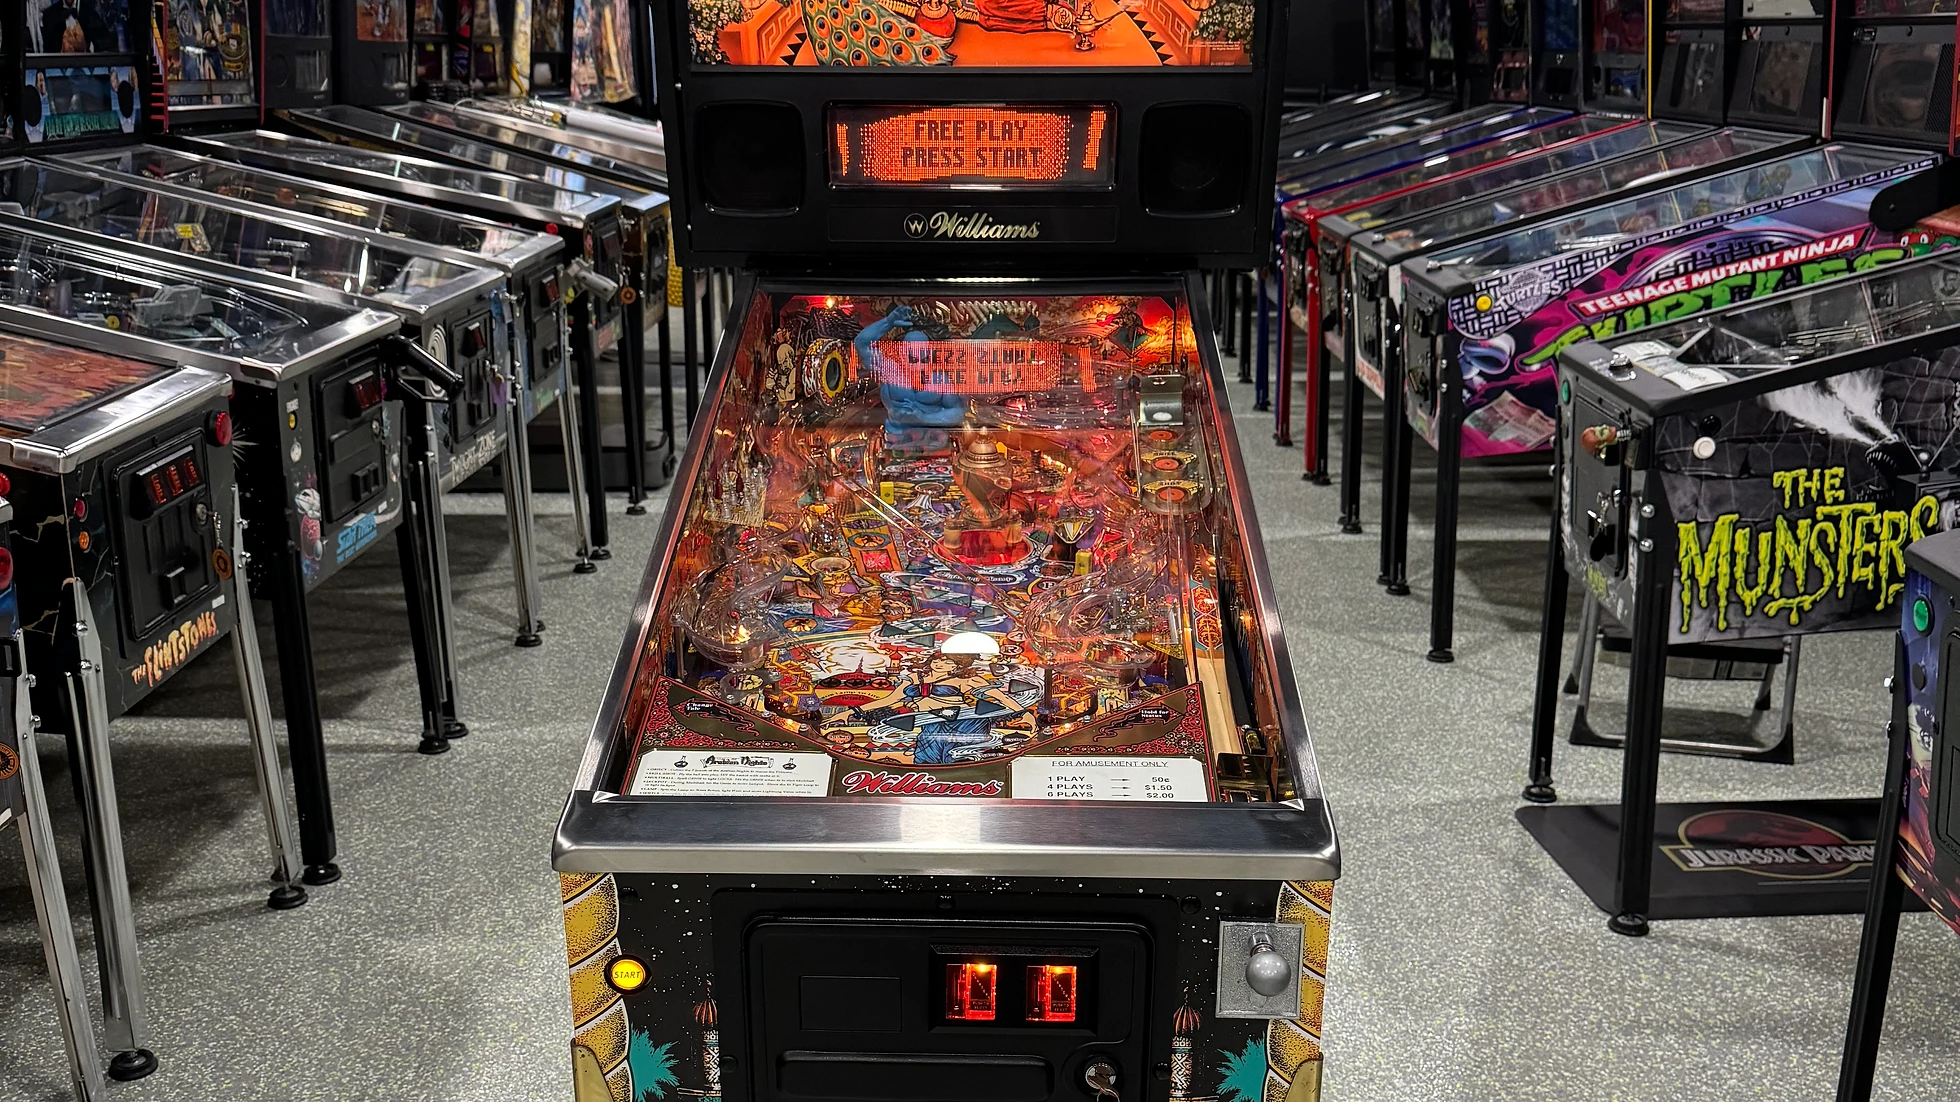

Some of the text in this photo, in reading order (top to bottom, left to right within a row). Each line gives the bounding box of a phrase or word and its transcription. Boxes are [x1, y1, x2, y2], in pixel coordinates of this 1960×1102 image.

[914, 119, 1028, 141] FREE PLAY
[902, 146, 1042, 168] PRESS START
[929, 211, 1040, 239] Williams
[1581, 233, 1855, 314] TEENAGE MUTANT NINJA
[1495, 279, 1561, 312] TURTLES
[1773, 466, 1845, 510] THE
[144, 611, 217, 688] FLINTSTONES
[706, 755, 768, 767] Arabian Nights
[841, 770, 1002, 796] Williams
[1680, 845, 1876, 868] JURASSIC PARK
[613, 971, 641, 979] START
